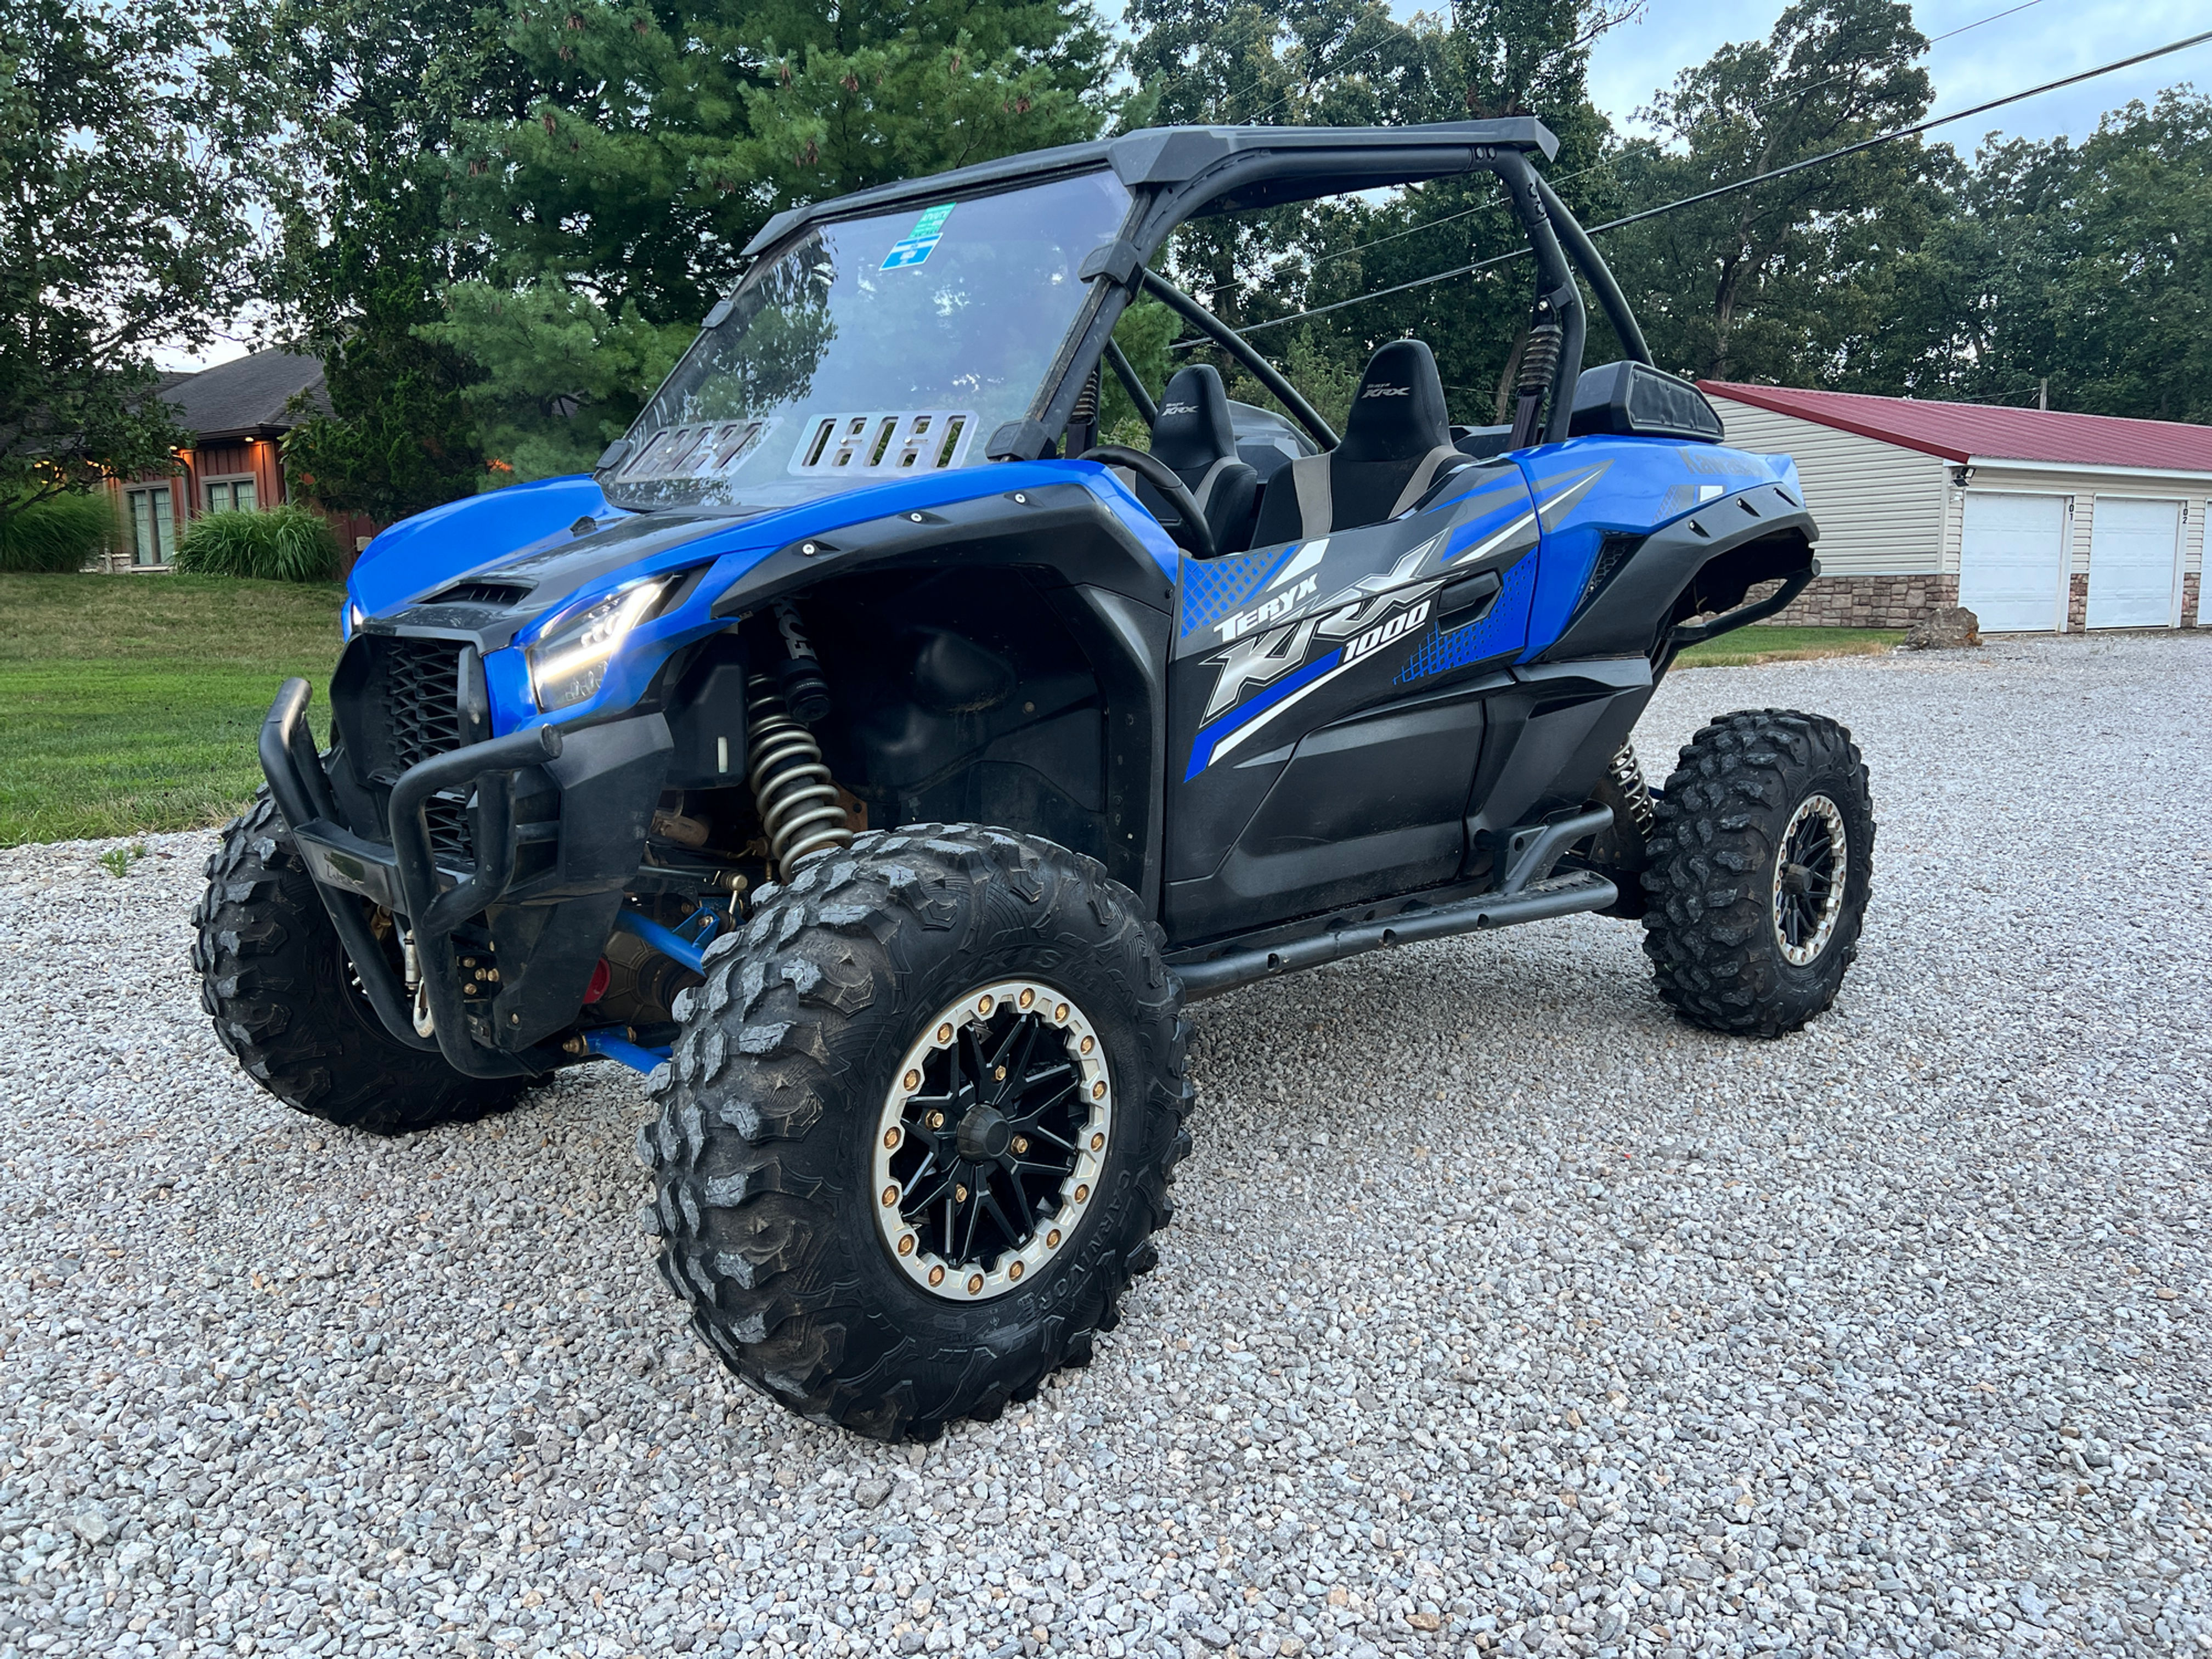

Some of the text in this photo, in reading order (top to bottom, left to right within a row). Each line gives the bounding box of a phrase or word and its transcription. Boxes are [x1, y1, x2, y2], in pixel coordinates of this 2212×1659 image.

[1361, 387, 1410, 399] KRX
[1199, 530, 1453, 727] KRX
[1212, 573, 1318, 642] TERYX
[1343, 600, 1431, 663] 1000
